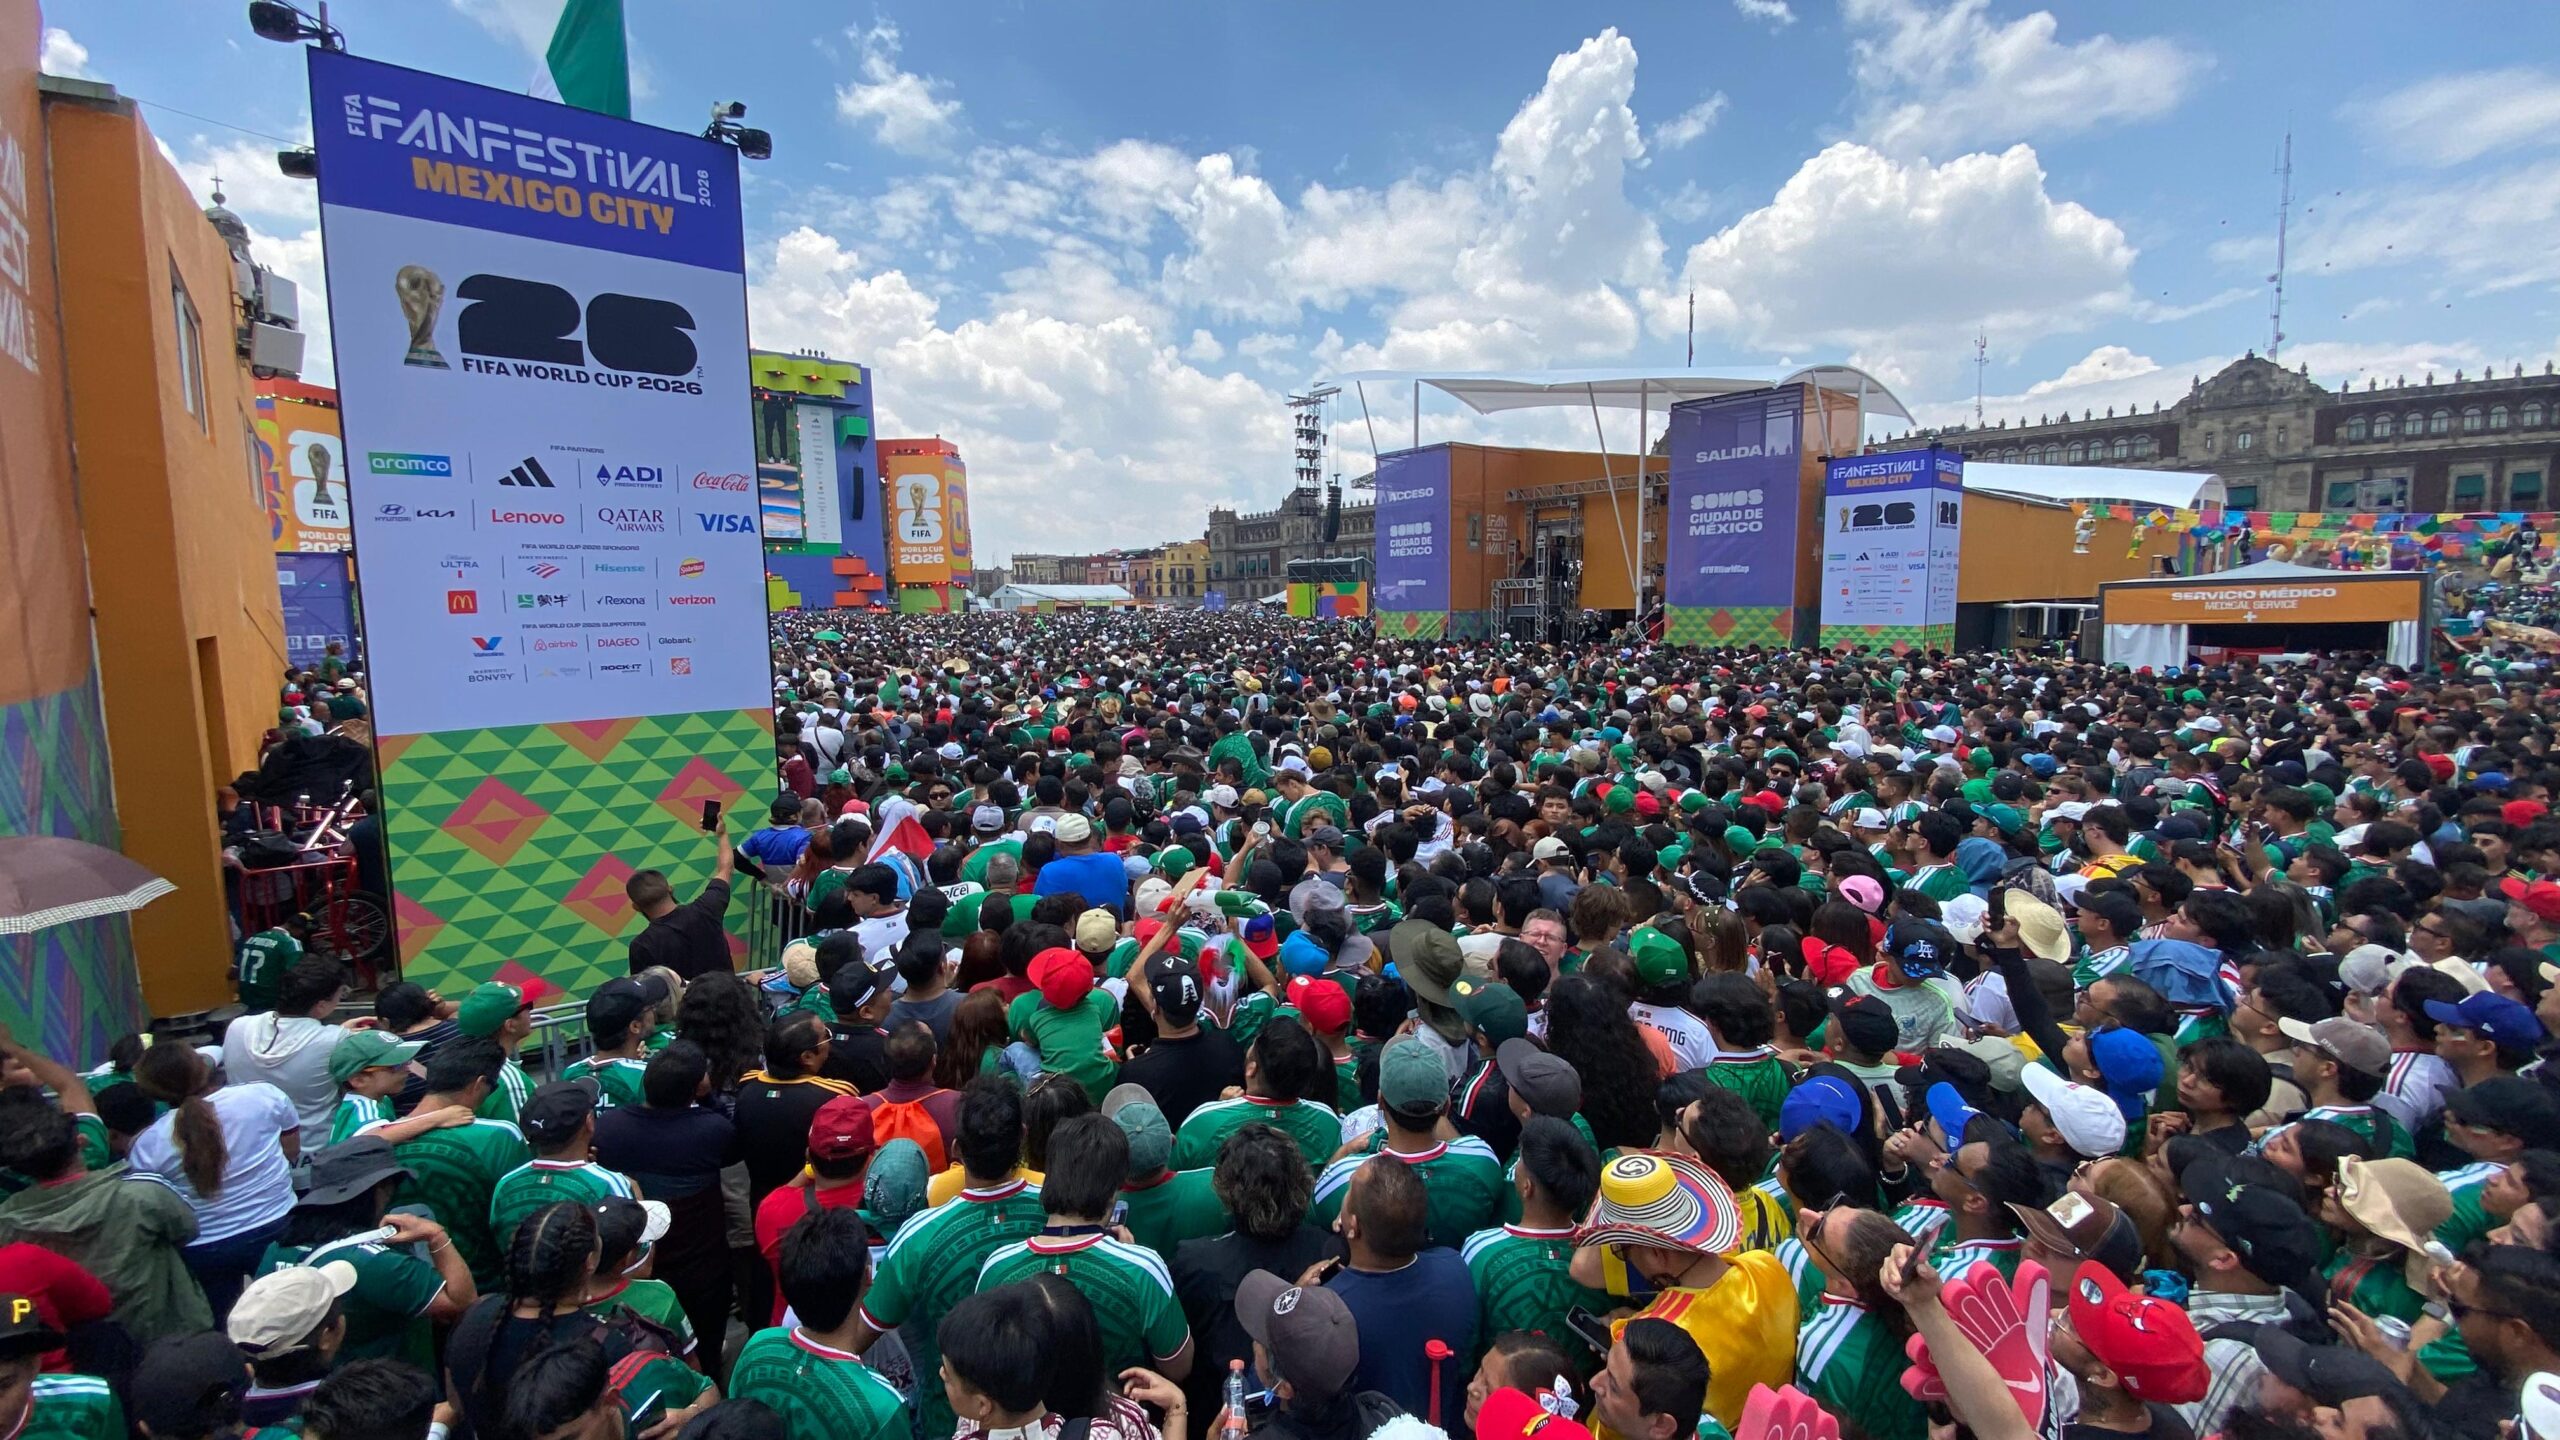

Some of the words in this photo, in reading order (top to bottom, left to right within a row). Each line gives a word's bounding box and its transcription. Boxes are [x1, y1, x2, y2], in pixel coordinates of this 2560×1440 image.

[344, 94, 366, 136] FIFA
[411, 156, 582, 218] MEXICO
[588, 191, 674, 235] CITY
[697, 169, 711, 207] 2026
[457, 273, 698, 377] 26
[462, 357, 511, 377] FIFA
[513, 363, 590, 385] WORLD
[594, 373, 633, 389] CUP
[637, 376, 703, 396] 2026
[567, 446, 605, 454] PARTNERS
[1696, 444, 1763, 463] SALIDA
[372, 457, 449, 472] aramco
[614, 466, 663, 483] ADI
[1845, 475, 1887, 488] MEXICO
[1887, 473, 1913, 485] CITY
[1388, 487, 1434, 503] ACCESO
[1690, 488, 1764, 510] SOMOS
[312, 508, 339, 520] FIFA
[491, 508, 565, 525] Lenovo
[598, 508, 664, 525] QATAR
[1690, 510, 1742, 524] CIUDAD
[1744, 508, 1764, 520] DE
[1853, 502, 1916, 527] 26
[616, 523, 665, 532] AIRWAYS
[694, 513, 756, 533] VISA
[1689, 520, 1763, 536] MÉXICO
[298, 530, 336, 540] WORLD
[336, 532, 351, 542] CU
[911, 529, 932, 538] FIFA
[1389, 537, 1421, 548] CIUDAD
[1421, 536, 1432, 545] DE
[900, 554, 945, 564] 2026
[595, 563, 646, 573] Hisense
[537, 594, 567, 608] 蒙牛
[605, 595, 645, 605] Rexona
[669, 594, 716, 605] verizon
[2171, 590, 2256, 600] SERVICIO
[2259, 587, 2337, 599] MÉDICO
[2204, 601, 2251, 610] MEDICAL
[2253, 600, 2299, 609] SERVICE
[548, 640, 578, 648] airbnb
[597, 637, 640, 647] DIAGEO
[13, 1298, 31, 1324] P
